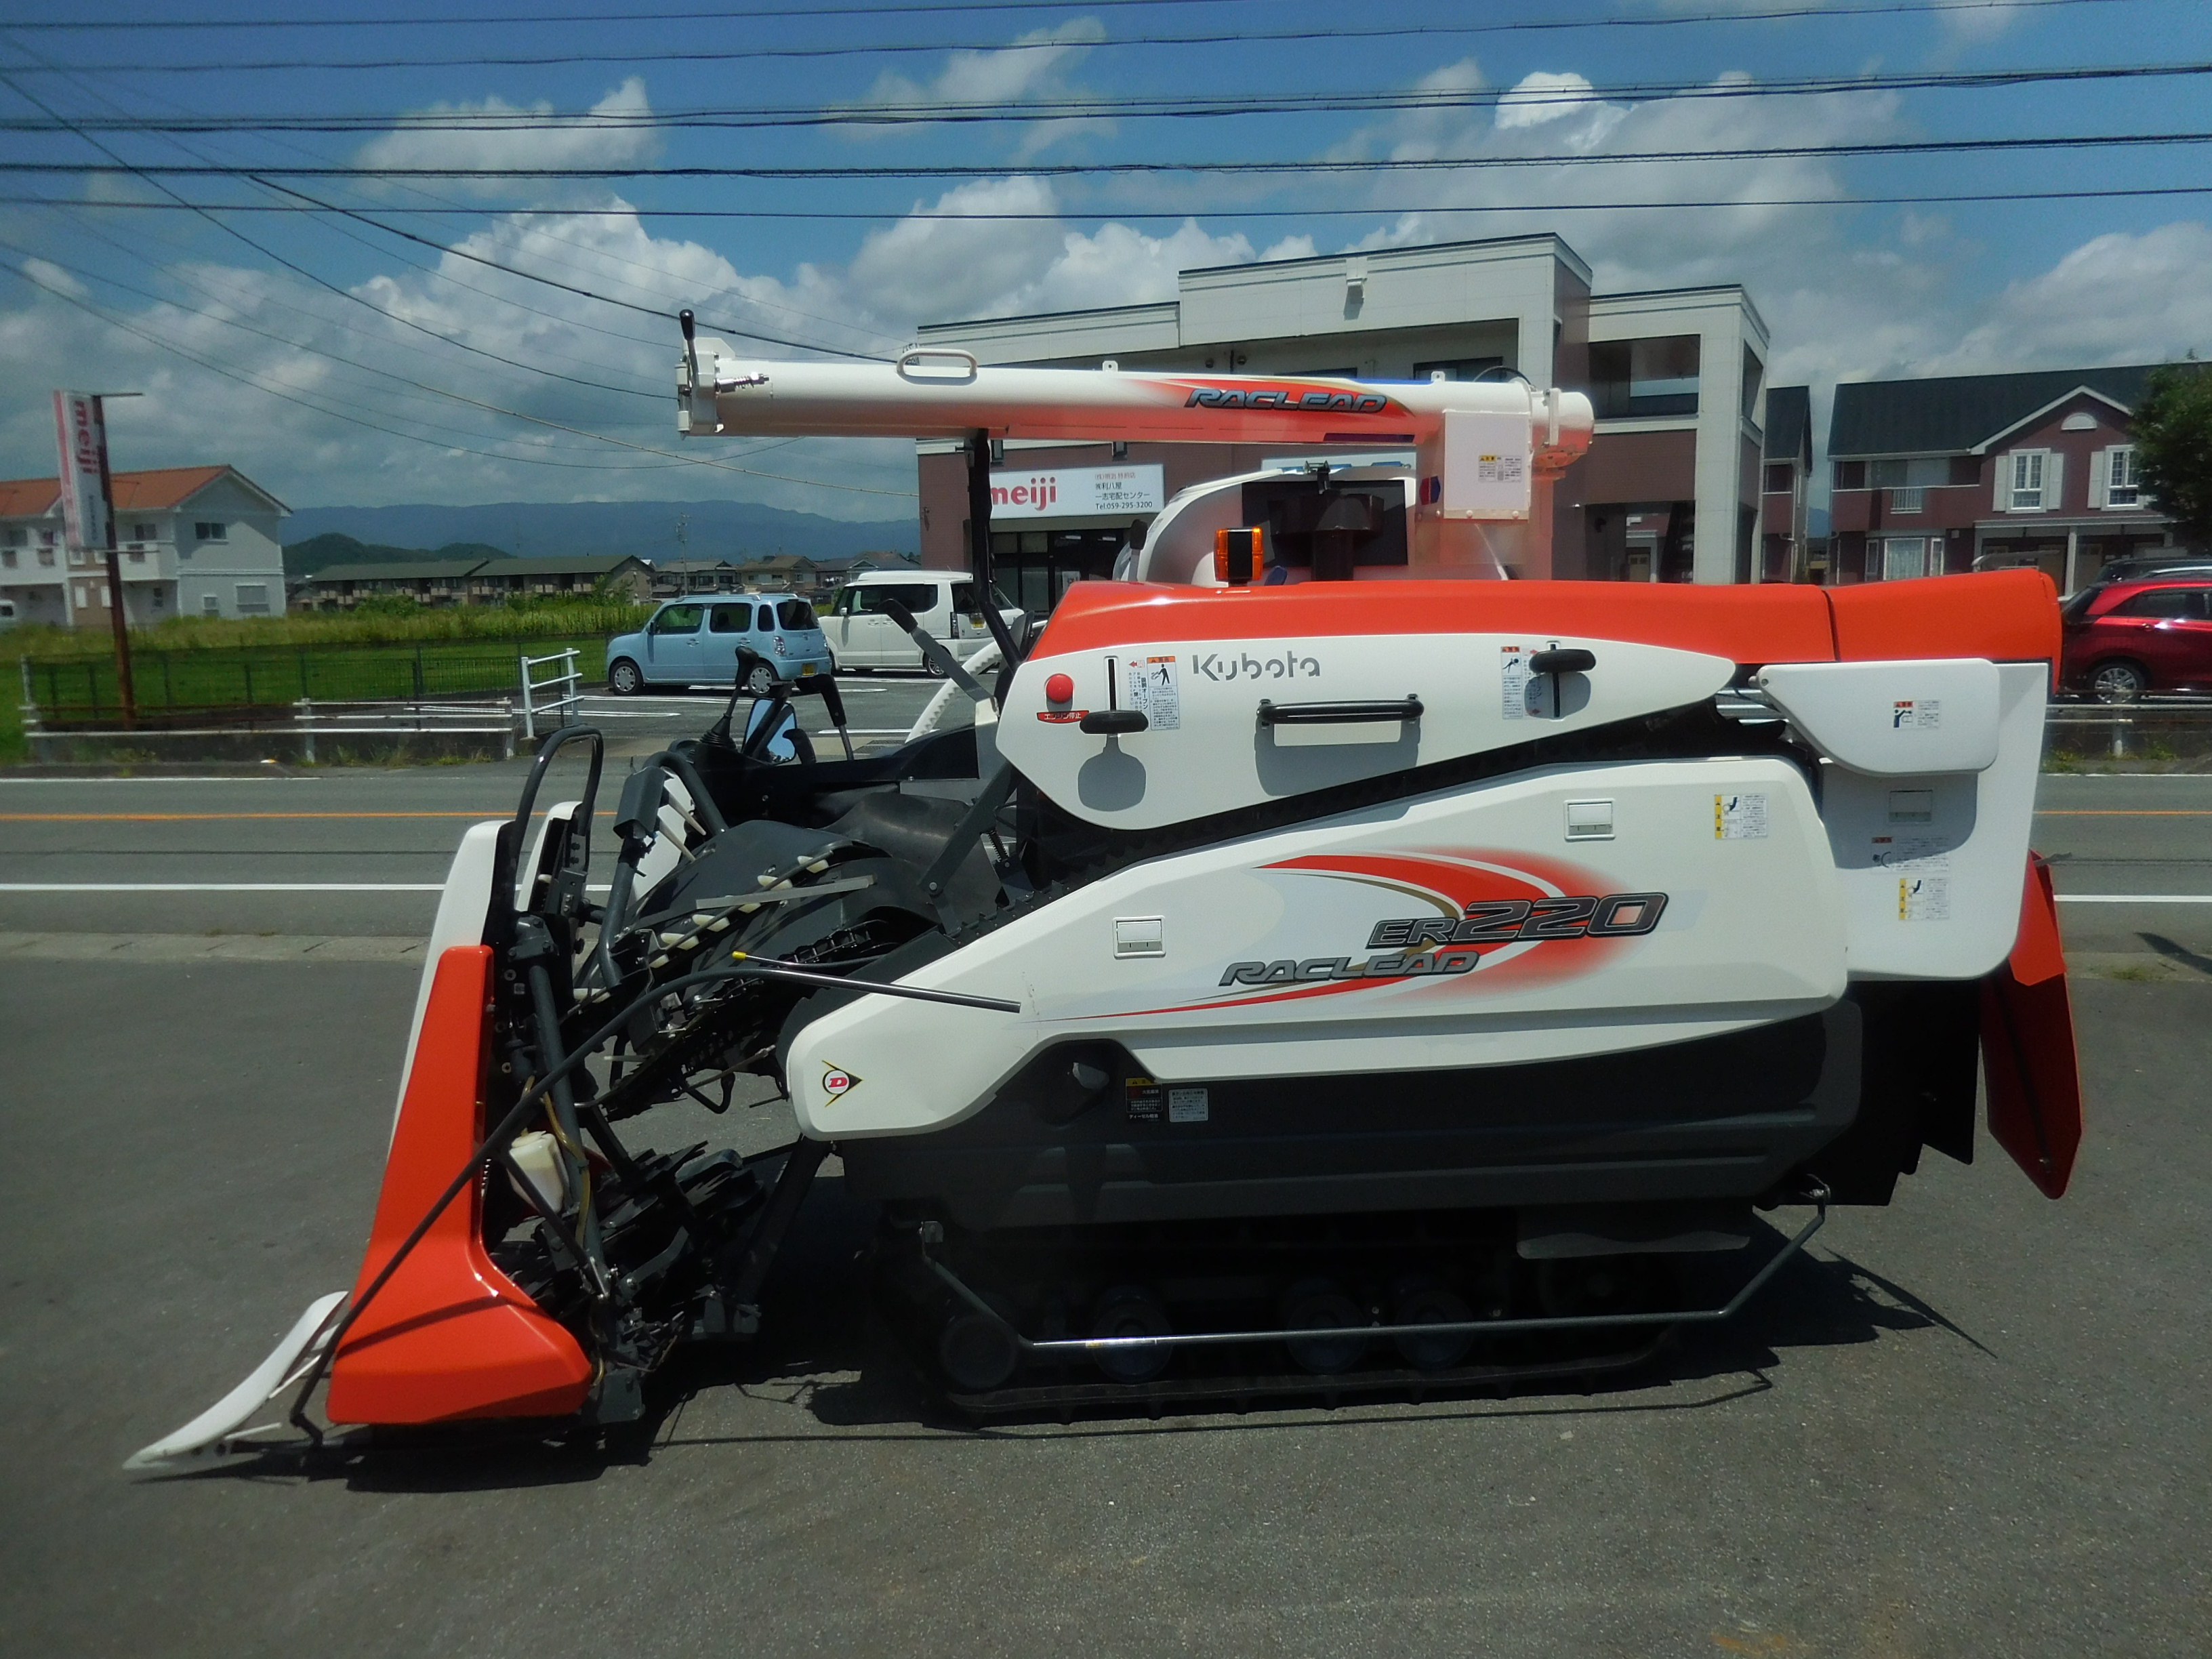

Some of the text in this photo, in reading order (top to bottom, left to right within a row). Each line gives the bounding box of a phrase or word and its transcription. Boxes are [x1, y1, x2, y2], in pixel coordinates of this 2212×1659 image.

[1186, 388, 1387, 413] RACLEAD
[75, 399, 97, 474] meiji
[1095, 491, 1150, 500] 一志宅配センター
[1192, 650, 1321, 682] Kubota
[1365, 892, 1669, 949] ER220
[1218, 951, 1481, 987] RACLEAD
[828, 1076, 848, 1088] D
